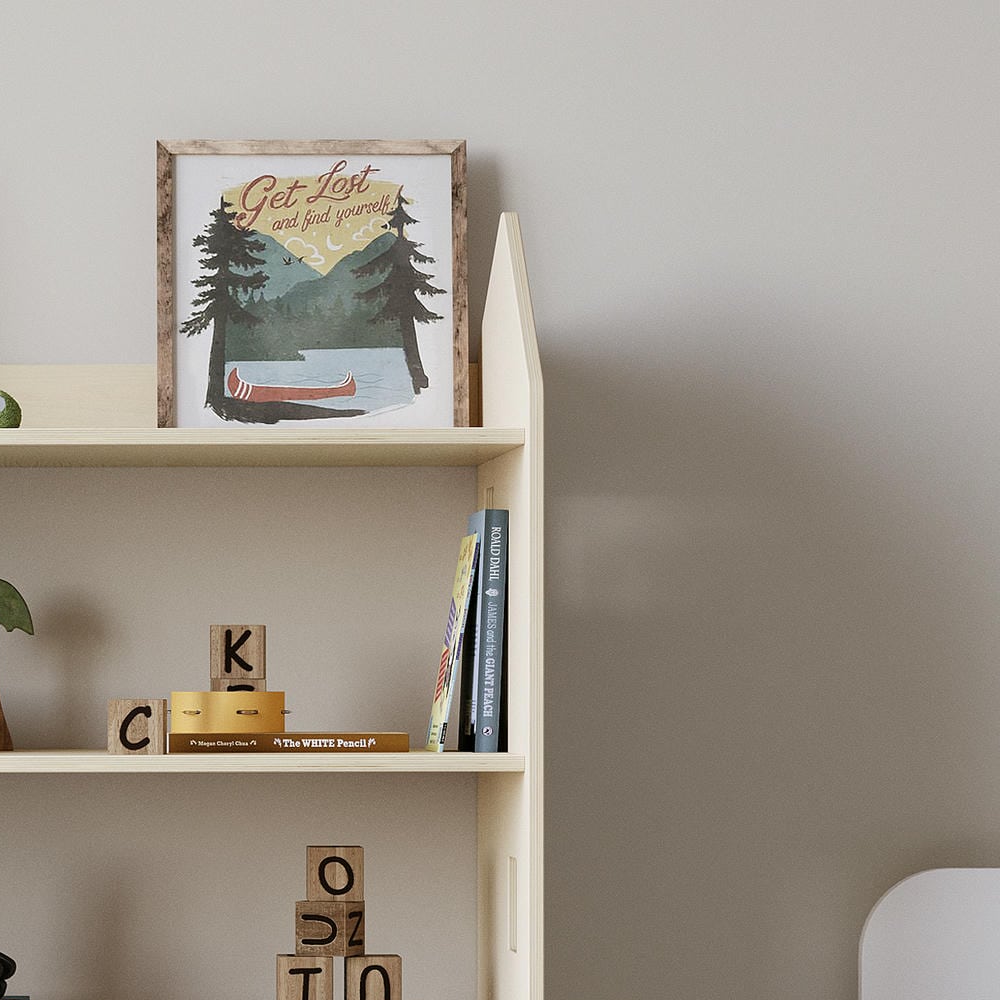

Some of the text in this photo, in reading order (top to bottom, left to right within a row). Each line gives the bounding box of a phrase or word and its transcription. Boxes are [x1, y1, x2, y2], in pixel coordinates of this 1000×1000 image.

[235, 159, 381, 230] Get Lost
[272, 217, 300, 232] and
[301, 206, 332, 232] find
[488, 526, 502, 582] ROALD DAHL
[224, 628, 253, 673] K
[483, 601, 498, 717] JAMES and the GIANT PEACH
[118, 705, 152, 751] C
[282, 738, 367, 748] The WHITE Pencil
[318, 856, 354, 895] O
